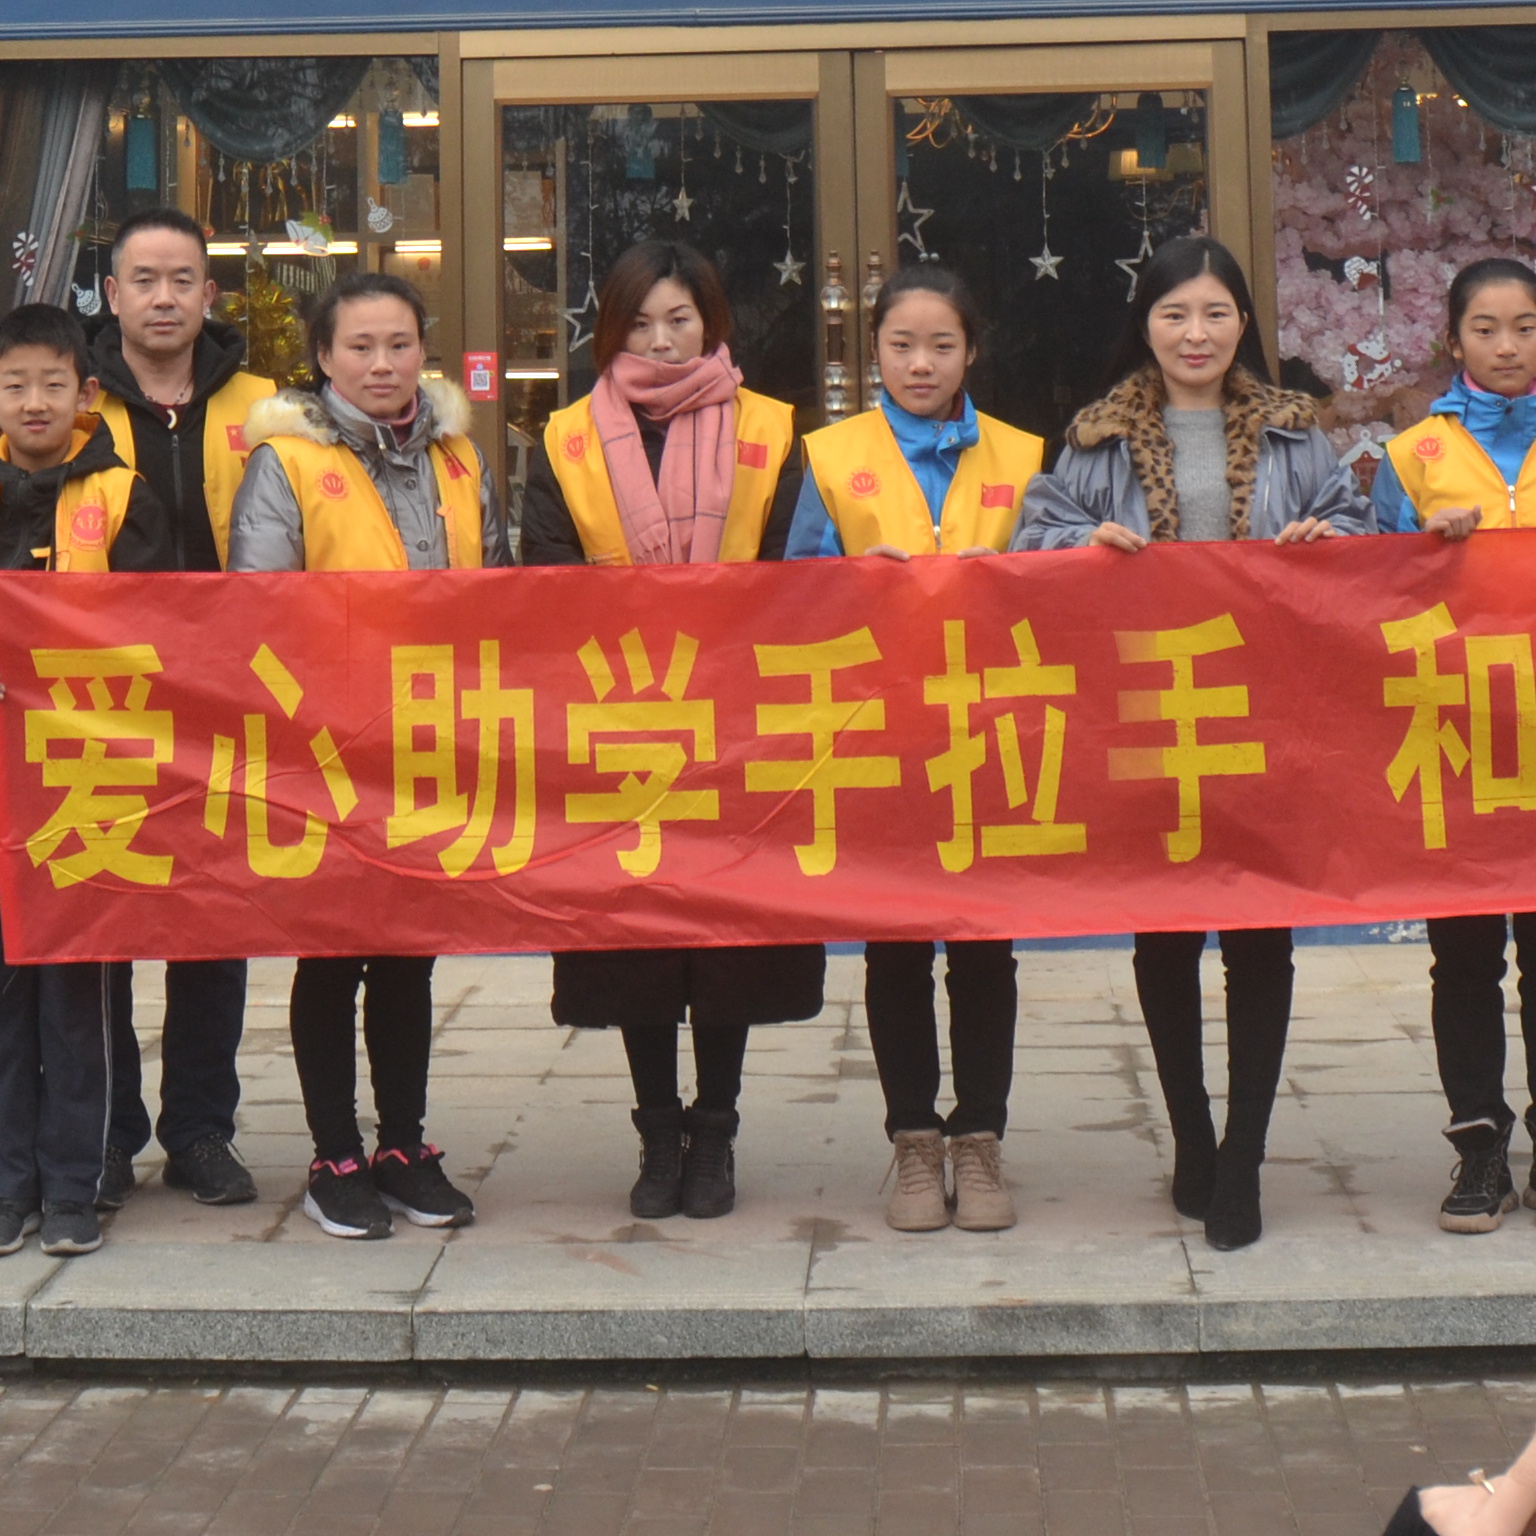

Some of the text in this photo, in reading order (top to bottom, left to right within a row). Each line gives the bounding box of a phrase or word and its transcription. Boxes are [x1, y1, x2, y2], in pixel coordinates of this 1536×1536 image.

[22, 610, 1268, 890] 爱心助学手拉手
